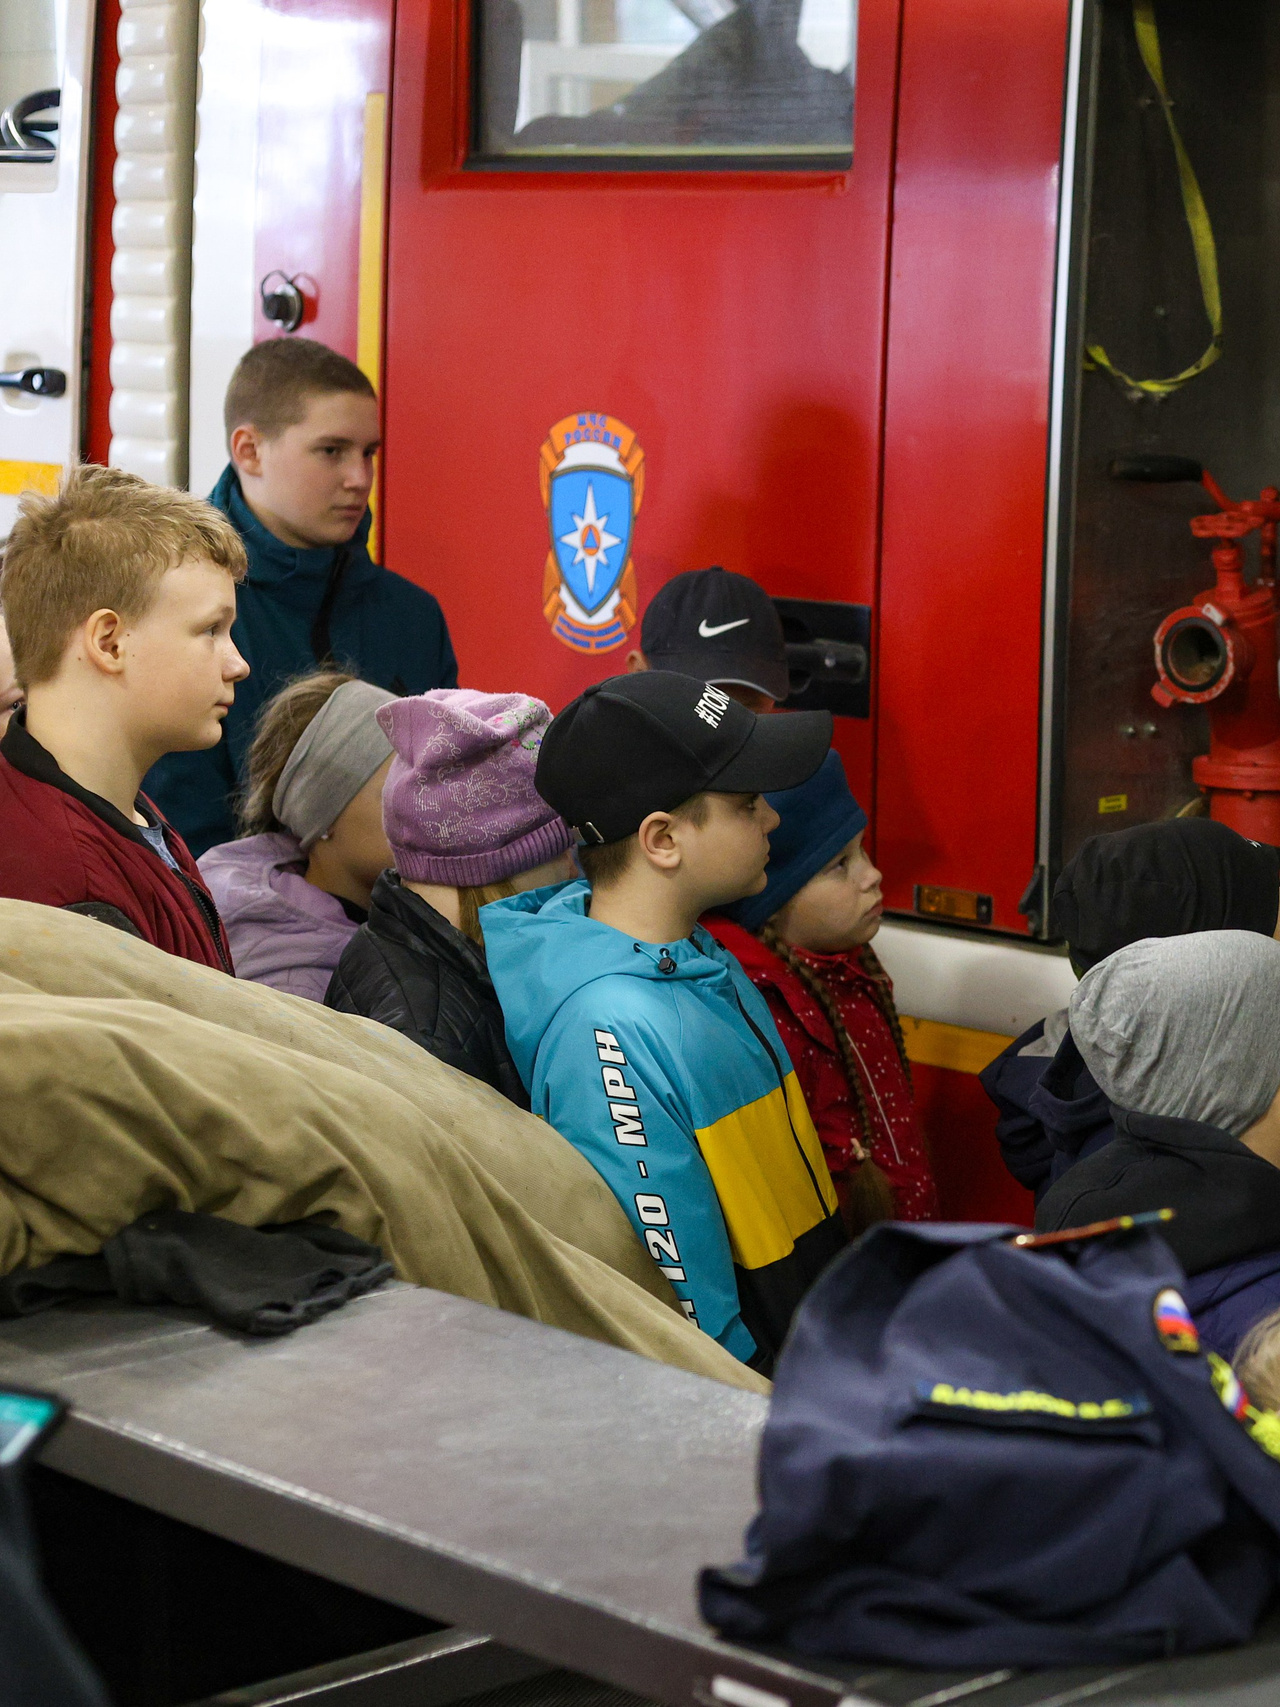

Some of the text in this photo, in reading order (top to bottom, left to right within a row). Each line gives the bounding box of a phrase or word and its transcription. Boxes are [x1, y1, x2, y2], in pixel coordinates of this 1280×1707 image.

[564, 428, 622, 449] РОССИИ
[577, 413, 607, 428] МЧС
[594, 1028, 648, 1147] MPH
[634, 1193, 688, 1283] 120
